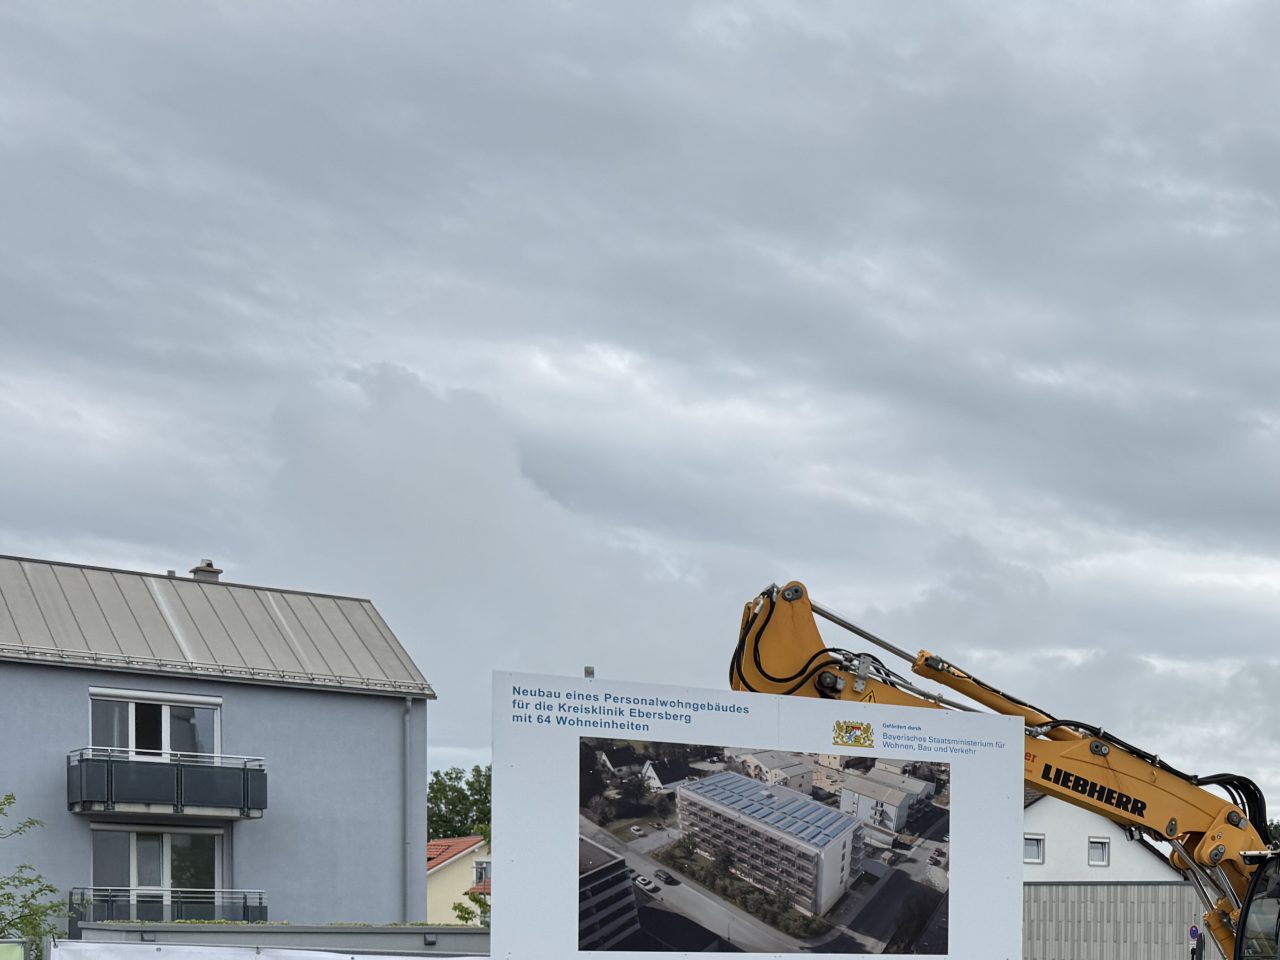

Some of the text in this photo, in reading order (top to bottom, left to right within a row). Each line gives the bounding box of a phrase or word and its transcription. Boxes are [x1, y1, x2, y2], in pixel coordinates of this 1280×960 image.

[512, 686, 750, 714] Neubau eines Personalwohngebäudes
[512, 699, 692, 724] für die Kreisklinik Ebersberg
[512, 713, 650, 732] mit 64 Wohneinheiten
[882, 732, 1006, 749] Bayerisches Staatsministerium für
[882, 741, 976, 755] Wohnen, Bau und Verkehr
[1041, 763, 1147, 819] LIEBHERR
